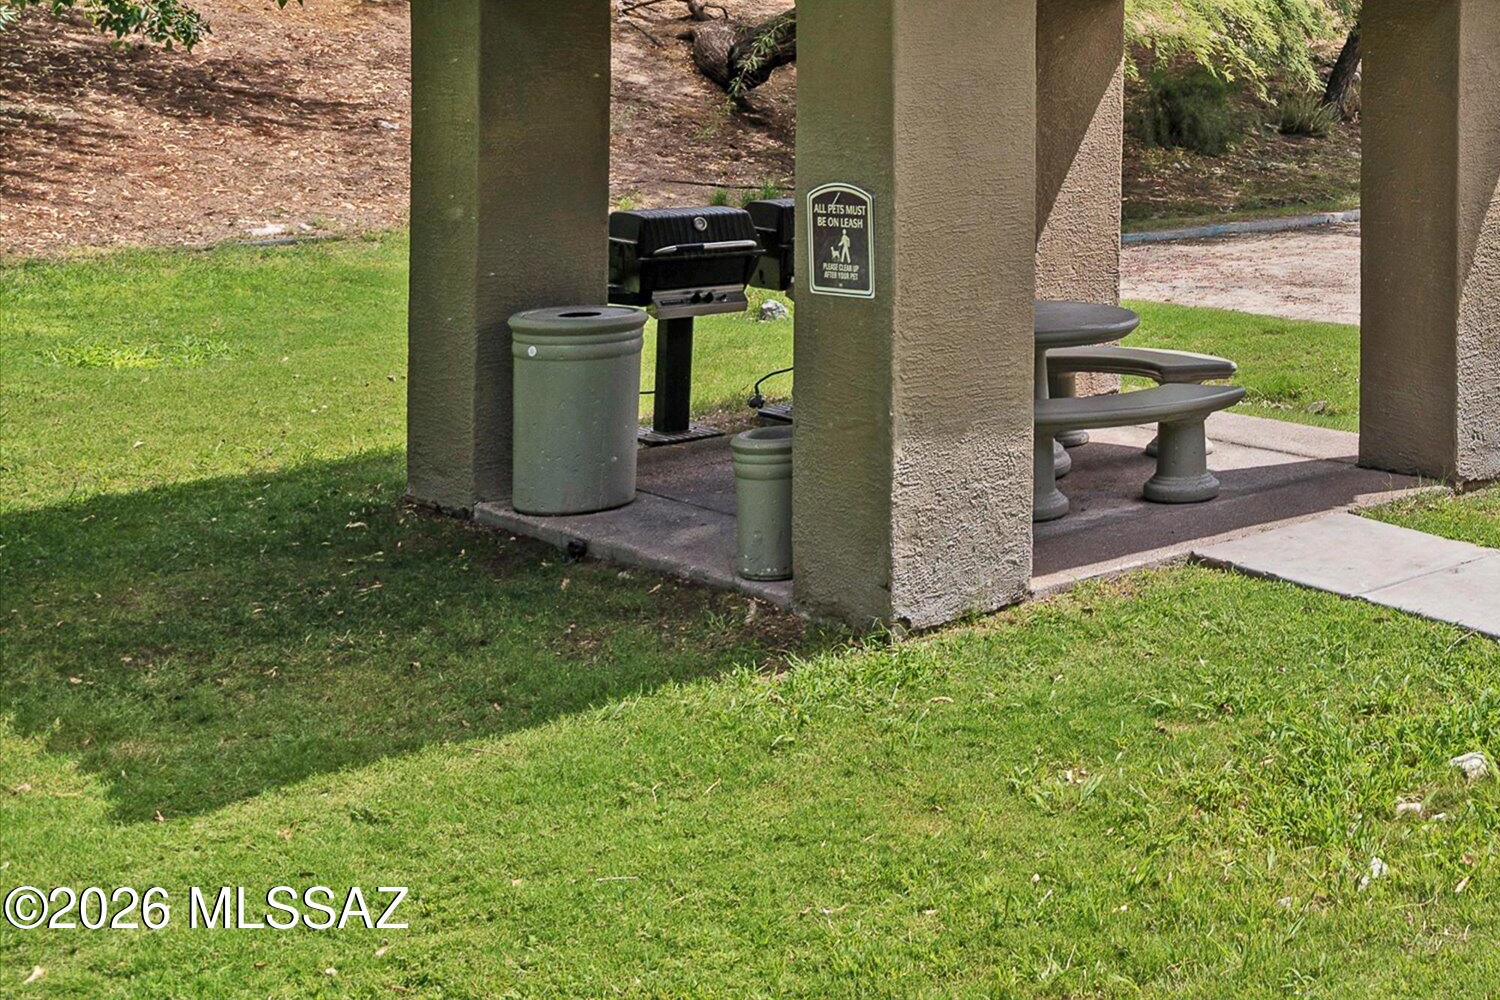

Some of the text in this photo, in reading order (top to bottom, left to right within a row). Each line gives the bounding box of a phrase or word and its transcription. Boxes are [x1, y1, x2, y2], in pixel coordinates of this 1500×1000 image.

[814, 204, 866, 215] ALL PETS MUST
[817, 216, 863, 228] BE ON LEASH
[823, 262, 838, 271] PLEASE
